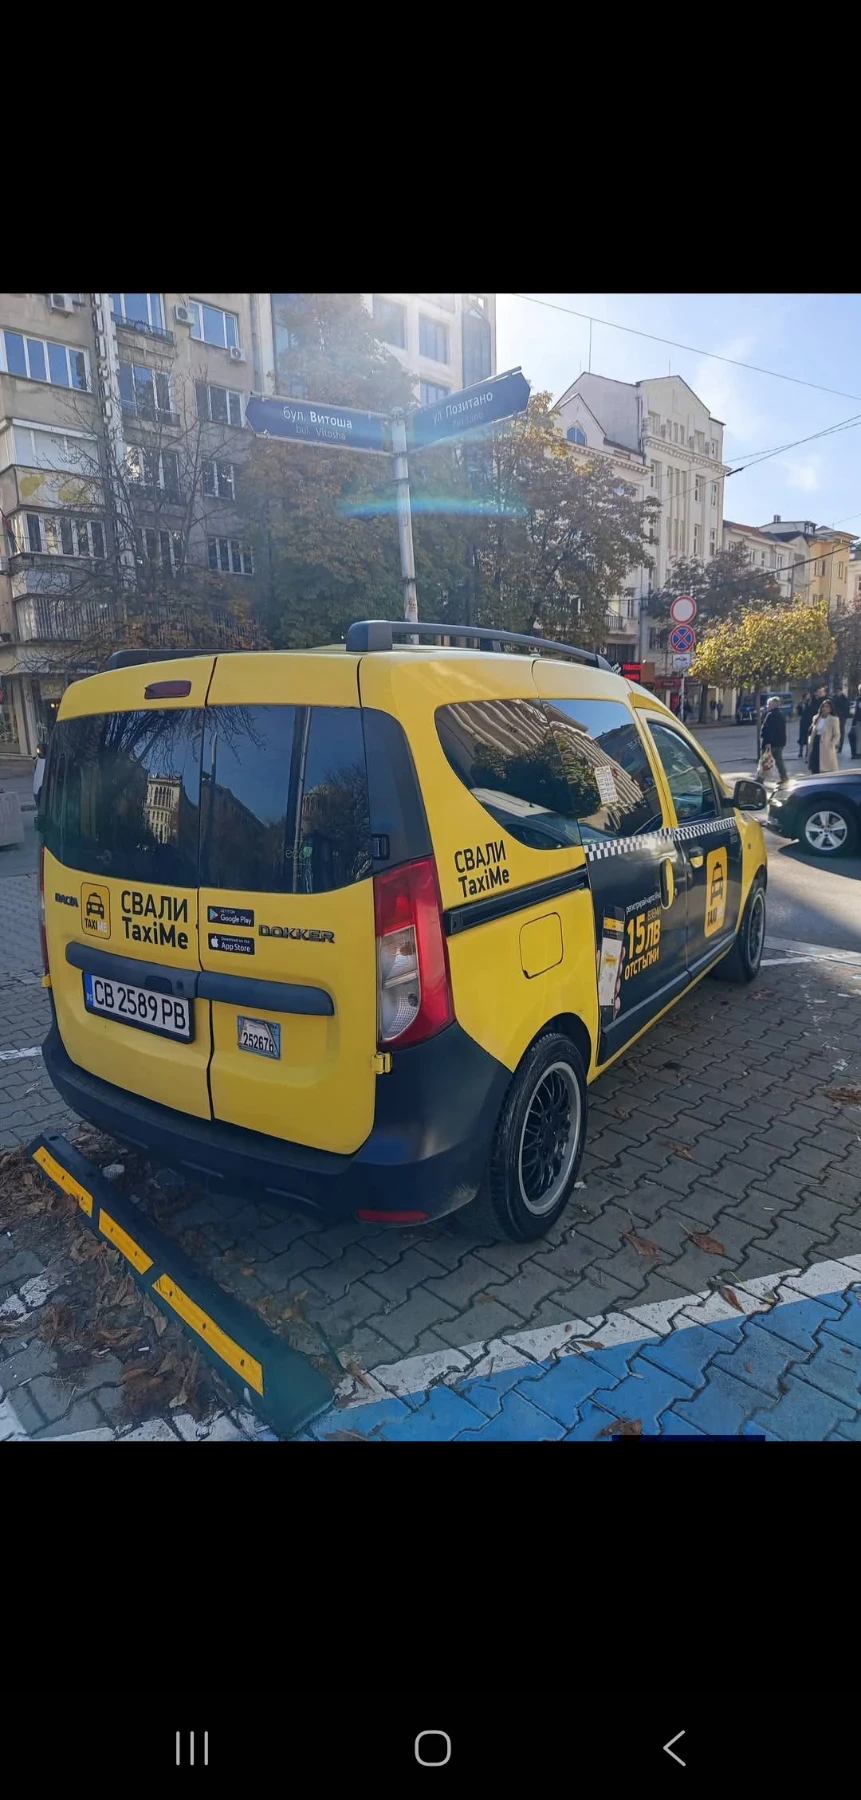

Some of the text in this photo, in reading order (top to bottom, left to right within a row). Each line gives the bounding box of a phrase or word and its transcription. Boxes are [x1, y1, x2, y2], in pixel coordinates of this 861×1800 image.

[445, 391, 493, 418] Позитано
[309, 411, 353, 429] Витоша
[316, 427, 346, 441] Vitosha
[454, 840, 506, 873] СВАЛИ
[458, 865, 510, 898] TaxiMe
[55, 892, 79, 908] DACIA
[121, 890, 188, 923] СВАЛИ
[121, 916, 189, 950] TaxiMe
[220, 914, 252, 925] Google Play
[221, 942, 251, 953] App Store
[259, 925, 335, 944] DOKKER
[627, 913, 660, 960] 15 ЛВ
[94, 980, 186, 1030] CB 2589 PB
